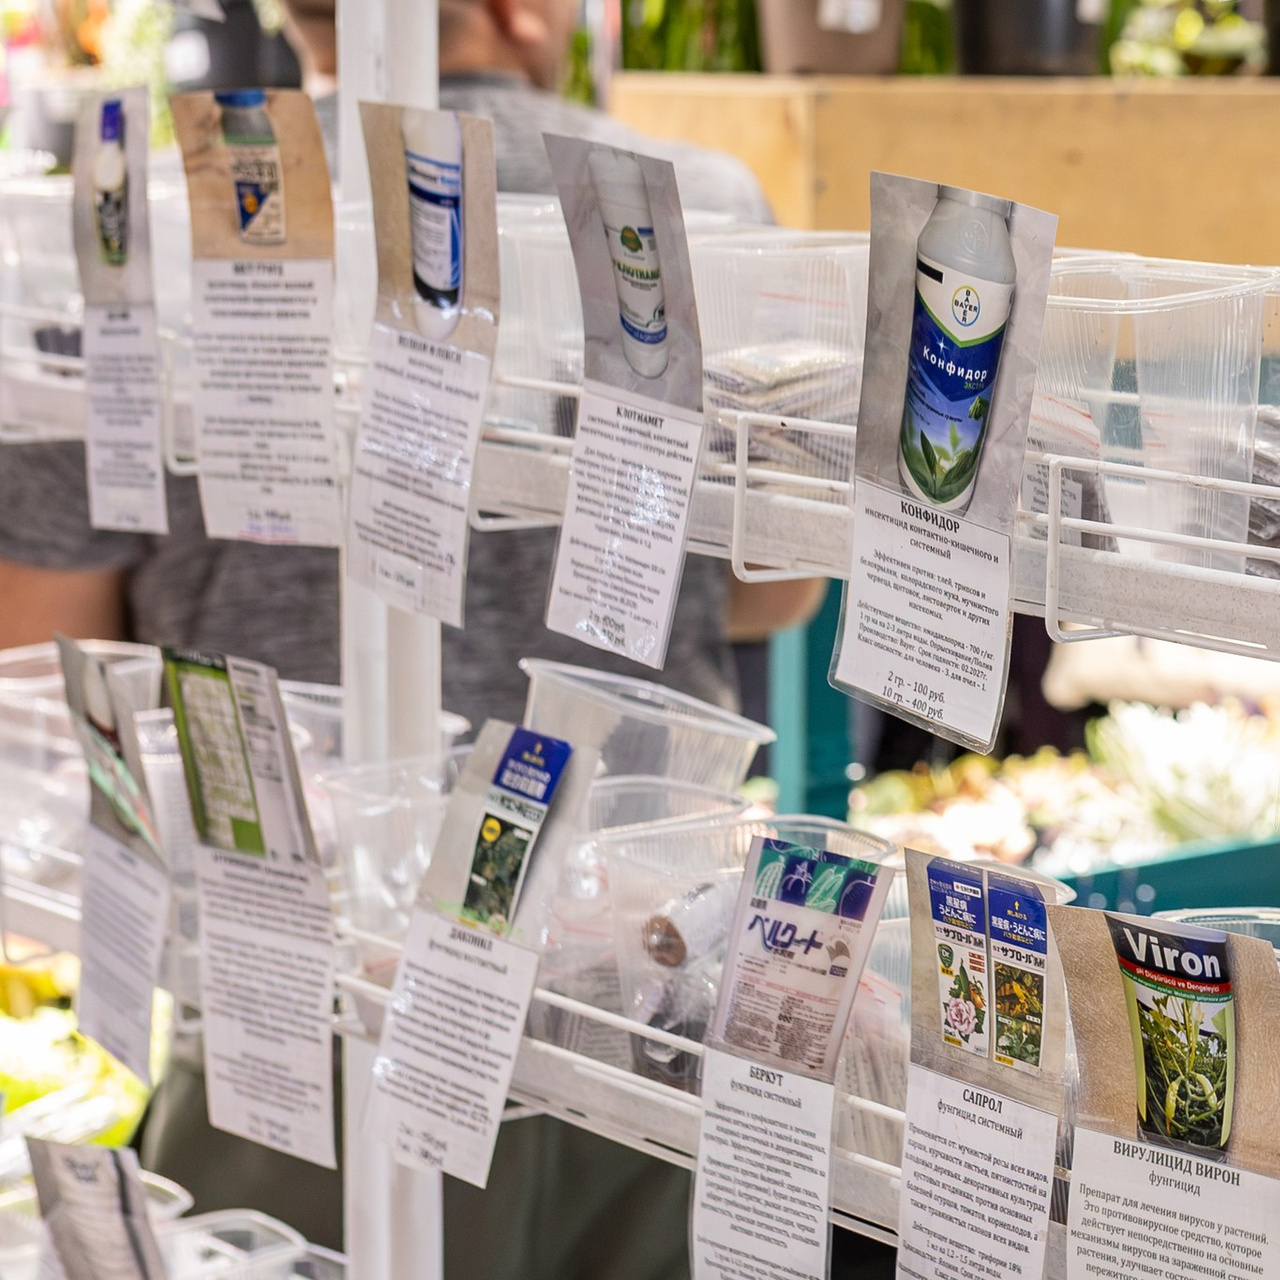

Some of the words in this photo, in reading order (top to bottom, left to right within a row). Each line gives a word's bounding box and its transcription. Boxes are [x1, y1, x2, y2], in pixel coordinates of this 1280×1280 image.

[954, 300, 978, 313] BAYER
[923, 346, 987, 381] Конфидор
[900, 501, 960, 534] КОНФИДОР
[909, 538, 951, 559] системный
[1123, 927, 1221, 978] Viron
[963, 1089, 1002, 1113] САПРОЛ
[937, 1099, 976, 1124] фунгицид
[977, 1116, 1023, 1139] системный
[1113, 1140, 1192, 1176] ВИРУЛИЦИД
[1195, 1162, 1240, 1186] ВИРОН
[1149, 1171, 1200, 1196] фунгицид
[1079, 1183, 1121, 1203] Препарат
[1121, 1197, 1138, 1208] для
[1140, 1202, 1176, 1219] лечения
[1179, 1212, 1215, 1229] вирусов
[1224, 1225, 1268, 1245] растений.
